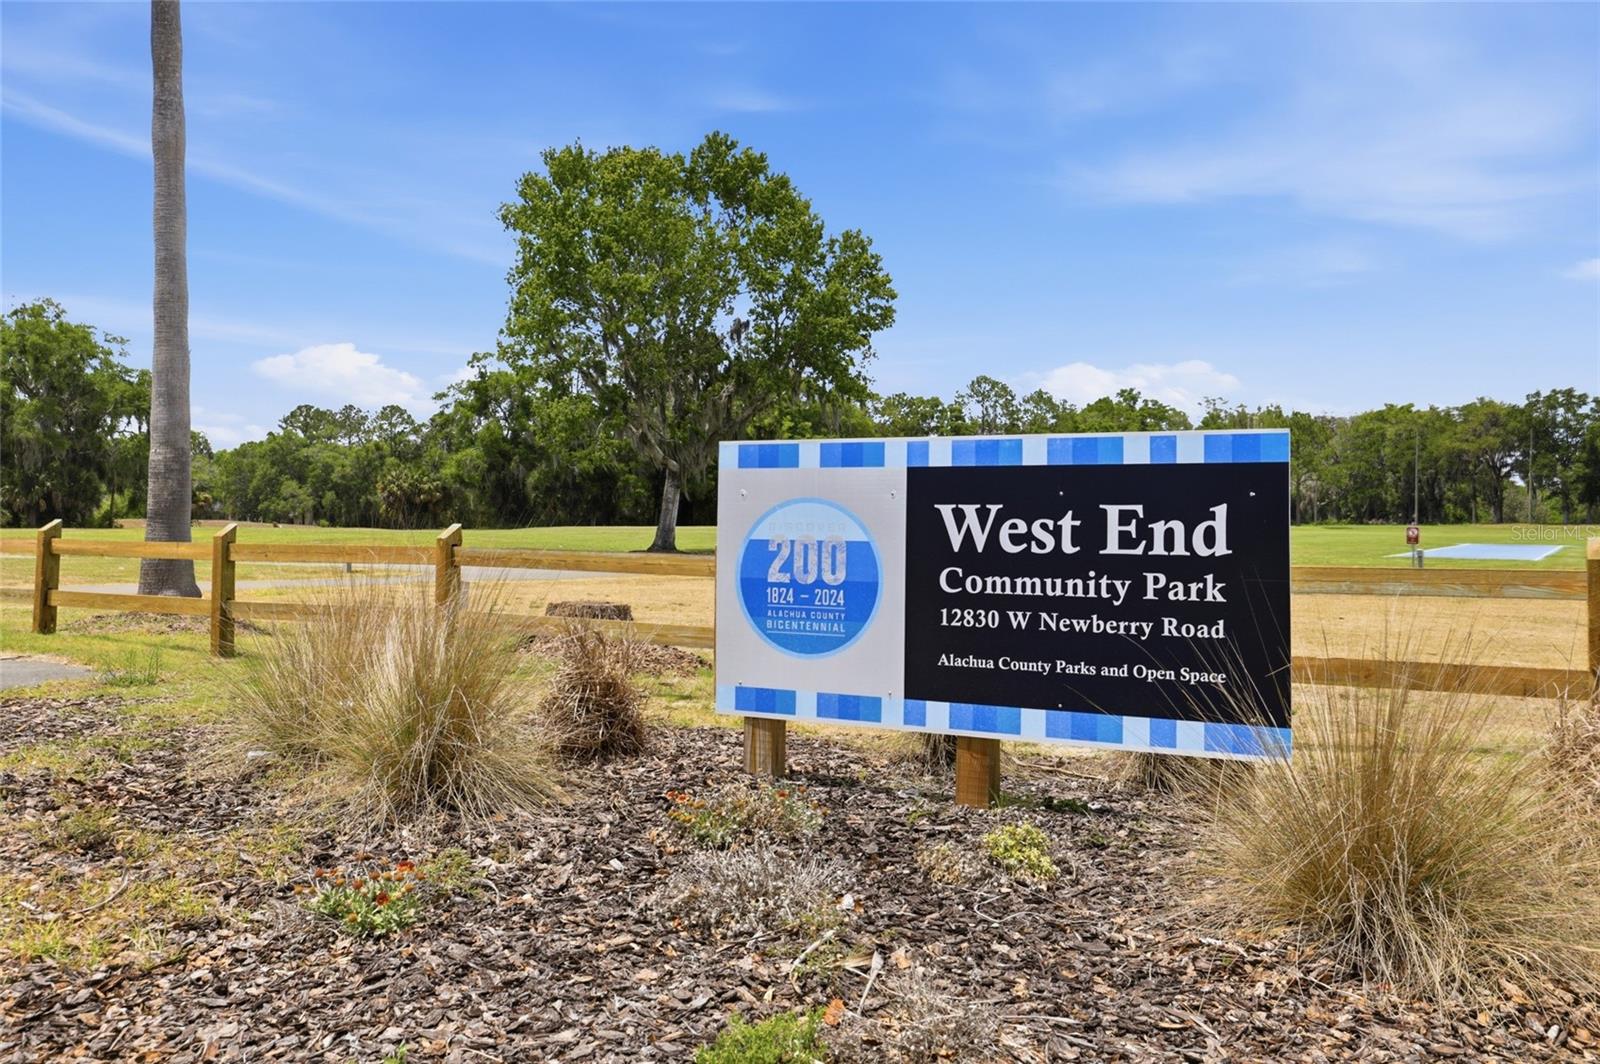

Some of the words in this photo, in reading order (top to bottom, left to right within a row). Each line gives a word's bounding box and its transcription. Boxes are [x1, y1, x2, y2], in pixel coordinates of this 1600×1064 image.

[934, 504, 1082, 554] West
[1099, 503, 1232, 557] End
[767, 534, 847, 586] 200
[766, 587, 794, 604] 1824
[814, 588, 845, 606] 2024
[939, 567, 1131, 606] Community
[1142, 572, 1227, 603] Park
[766, 620, 846, 633] BICENTENNIAL
[767, 610, 807, 619] ALACHUA
[811, 611, 845, 620] COUNTY
[940, 607, 1000, 629] 12830
[1006, 610, 1032, 630] W
[1038, 612, 1154, 640] Newberry
[1161, 617, 1226, 639] Road
[937, 653, 994, 669] Alachua
[998, 656, 1051, 676] County
[1055, 660, 1097, 676] Parks
[1100, 664, 1129, 678] and
[1133, 665, 1175, 682] Open
[1180, 667, 1227, 684] Space
